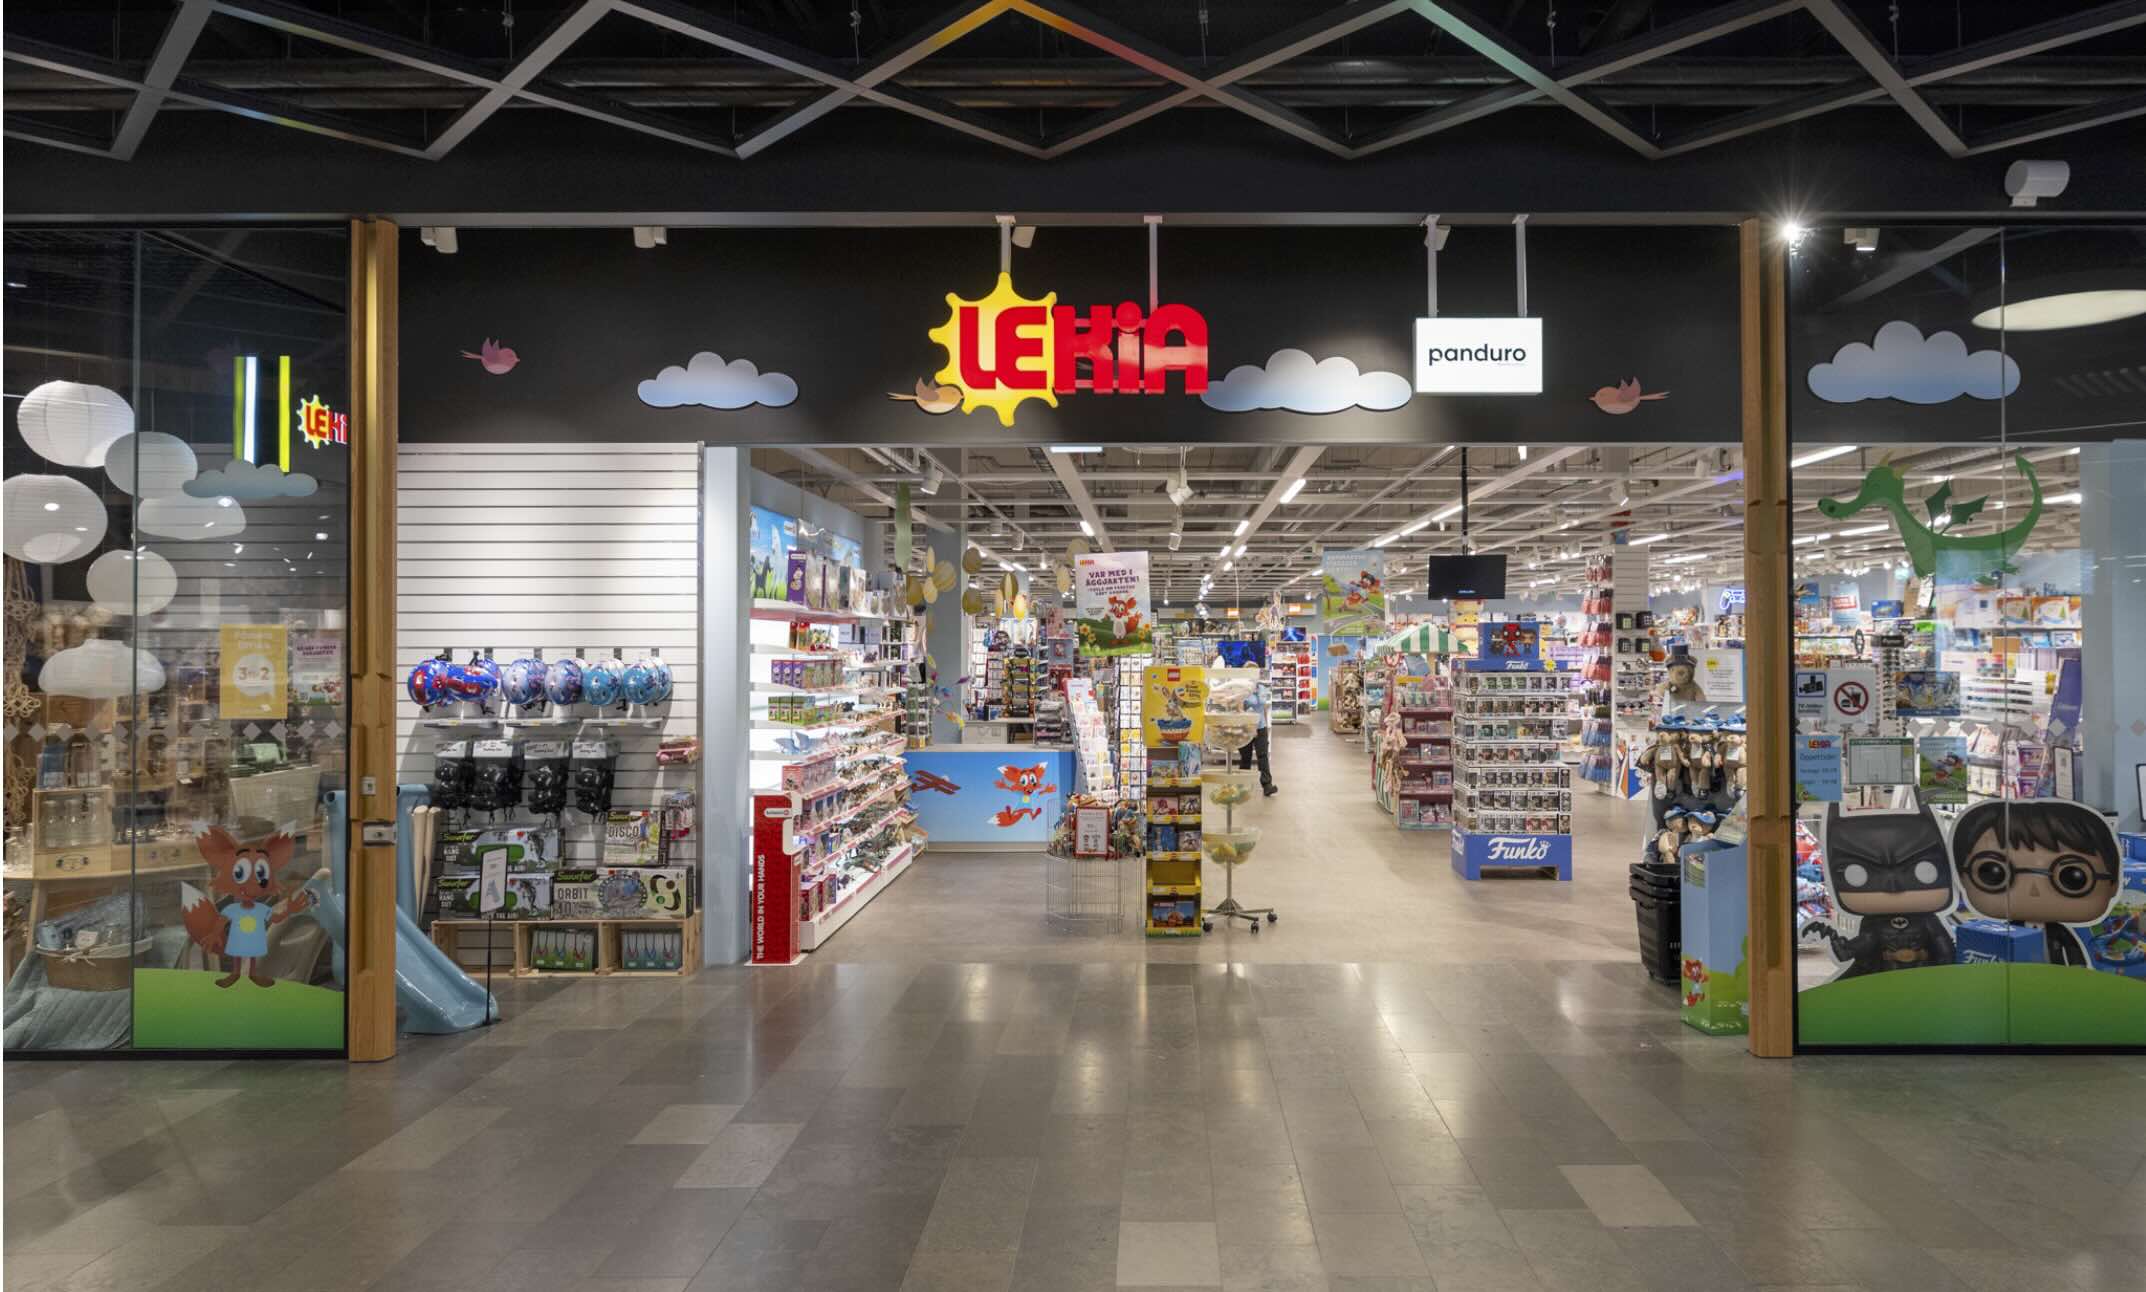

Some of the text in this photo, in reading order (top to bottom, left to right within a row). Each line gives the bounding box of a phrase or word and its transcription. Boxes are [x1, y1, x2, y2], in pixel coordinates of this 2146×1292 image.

[1428, 343, 1526, 367] panduro
[608, 825, 639, 838] DISCO
[1487, 837, 1548, 860] Funko
[557, 887, 589, 900] ORBIT
[757, 854, 766, 960] THE WORLD IN YOUR HANDS
